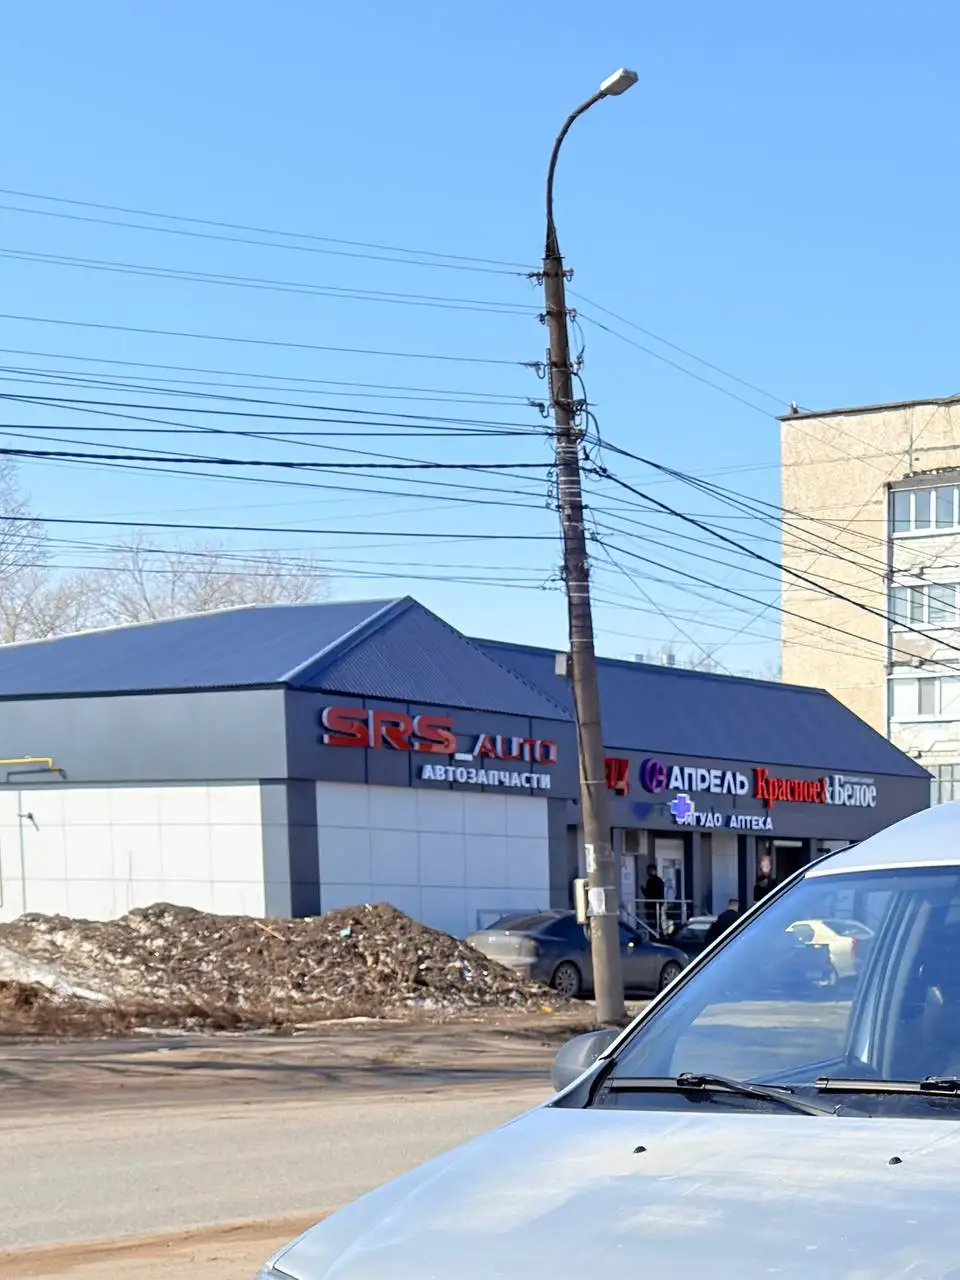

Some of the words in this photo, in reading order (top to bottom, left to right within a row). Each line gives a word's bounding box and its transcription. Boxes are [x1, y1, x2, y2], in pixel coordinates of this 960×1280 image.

[421, 764, 551, 789] АВТОЗАПЧАСТИ
[668, 765, 749, 796] АПРЕЛЬ
[729, 814, 774, 830] АПТЕКА
